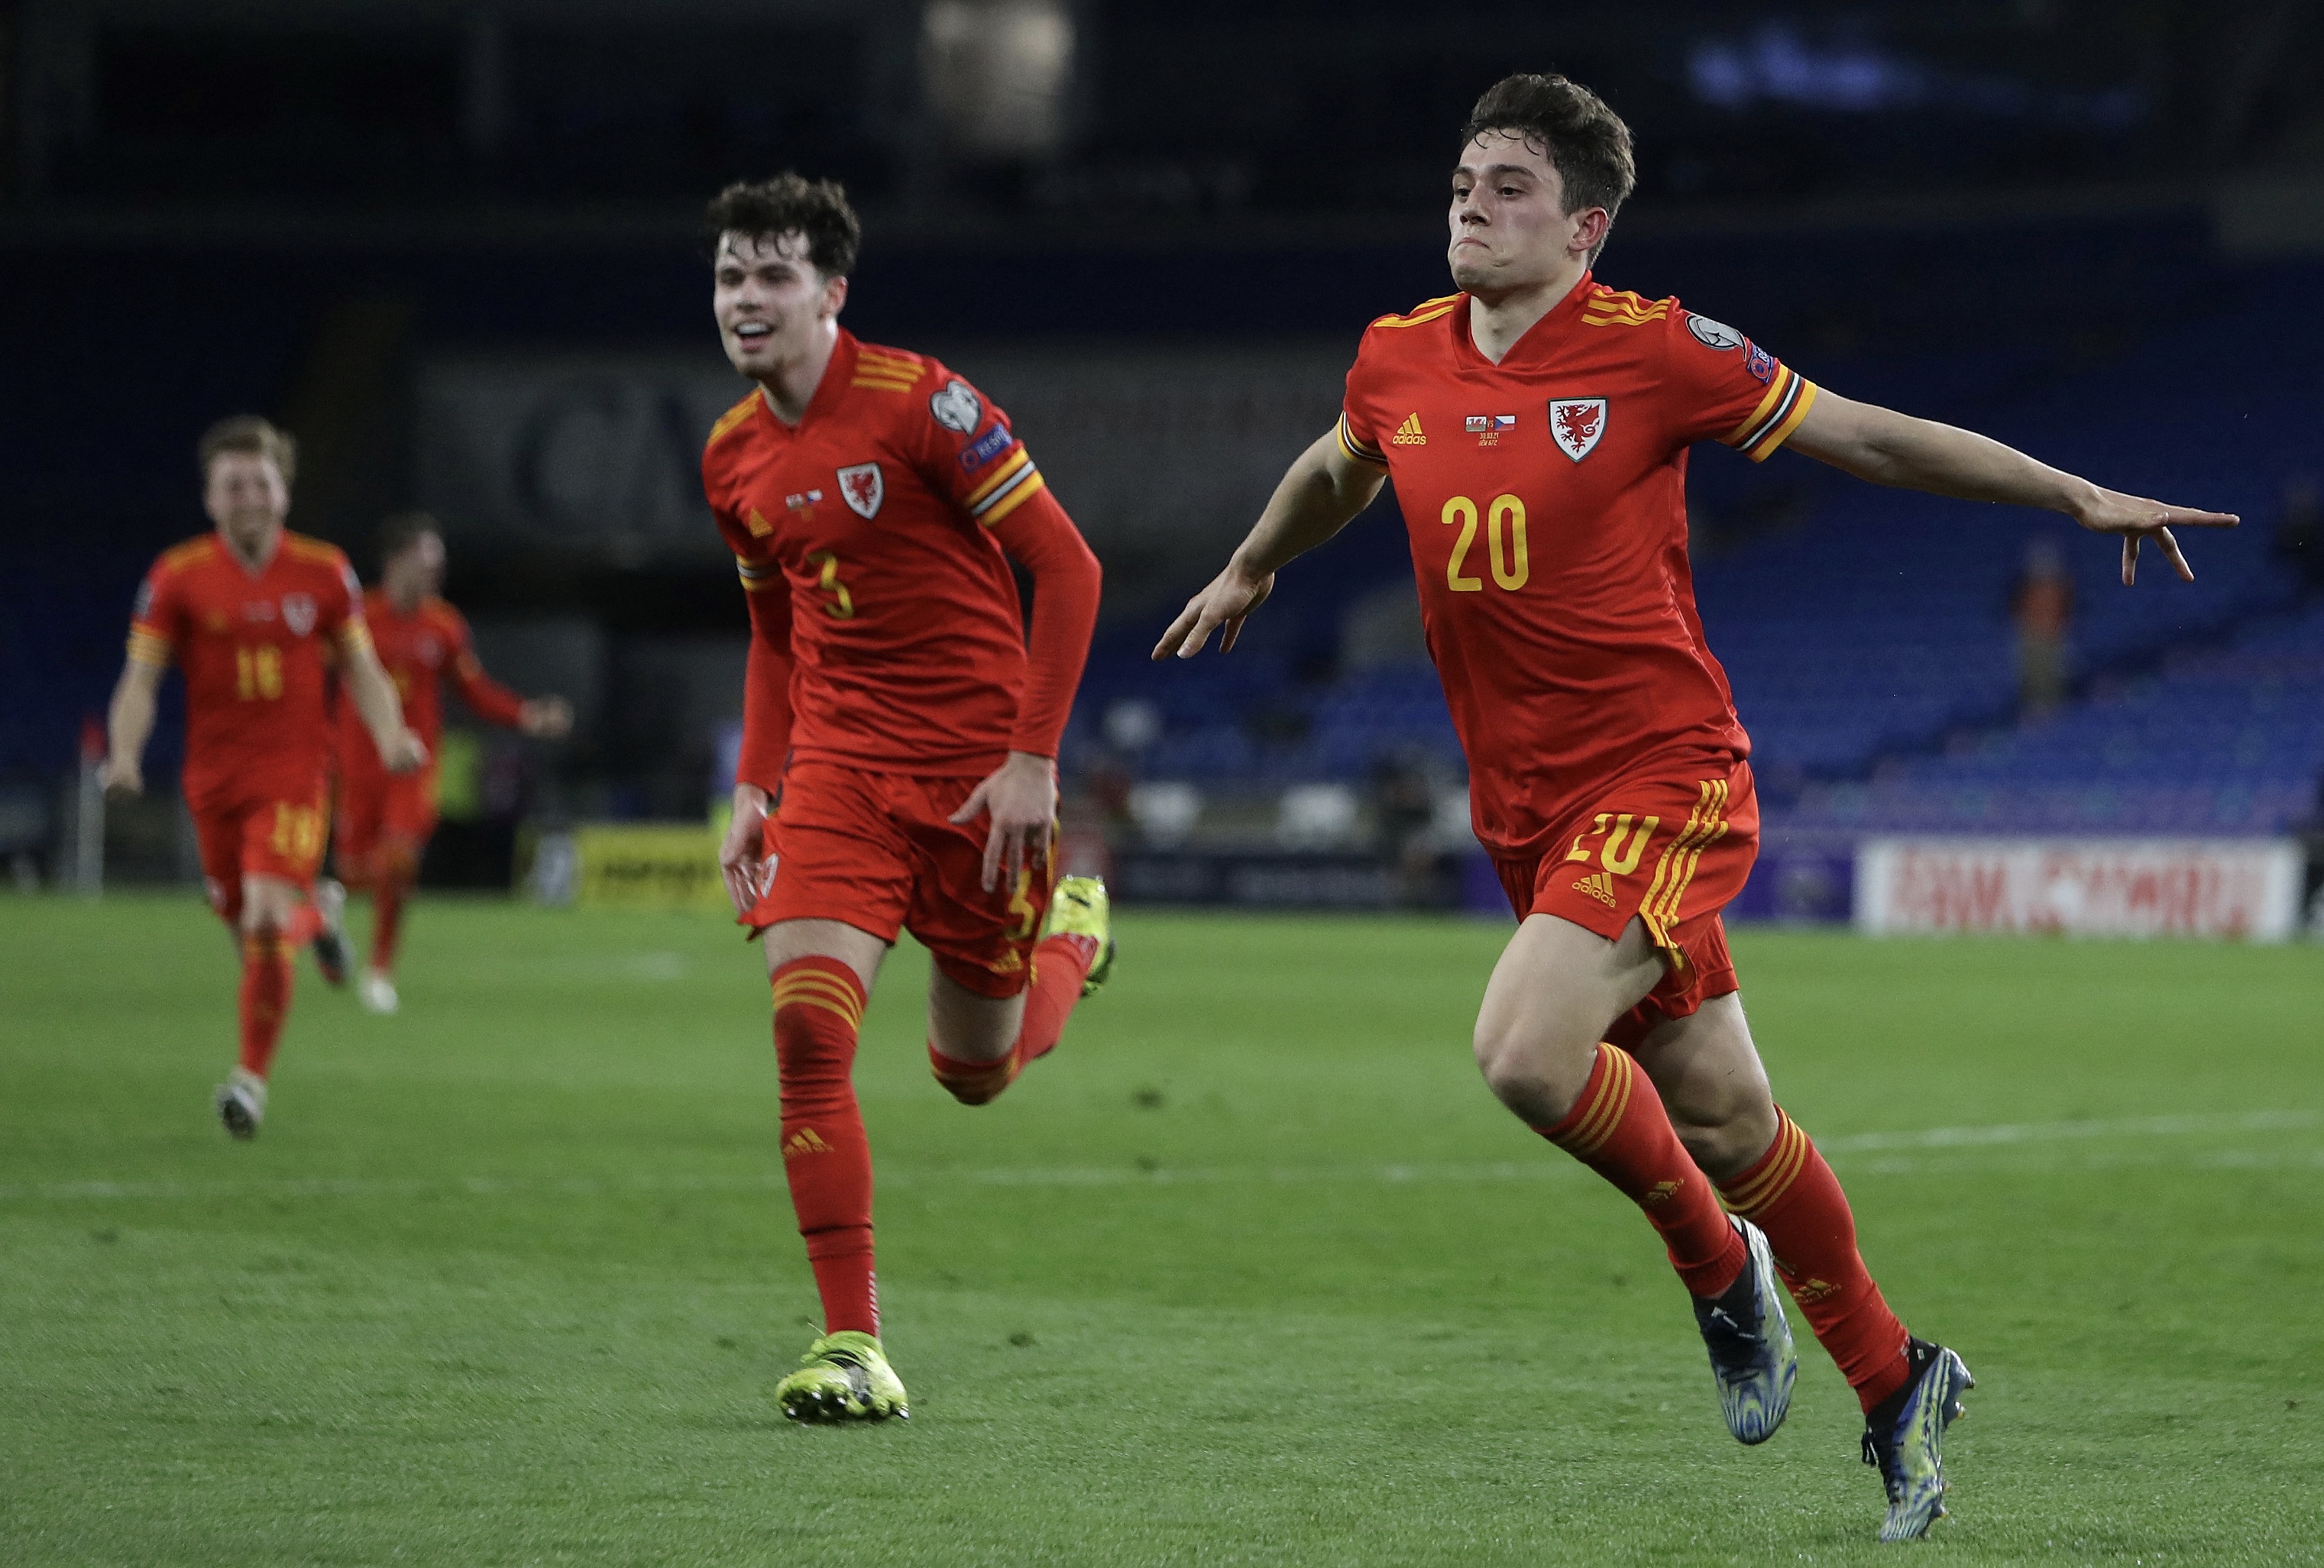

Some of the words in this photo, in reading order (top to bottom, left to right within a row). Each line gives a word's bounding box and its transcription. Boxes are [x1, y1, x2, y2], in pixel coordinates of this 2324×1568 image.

[1392, 433, 1427, 445] adidas
[1441, 493, 1529, 592] 20
[806, 551, 854, 619] 3
[1565, 813, 1660, 875] 20
[1571, 881, 1617, 908] adidas
